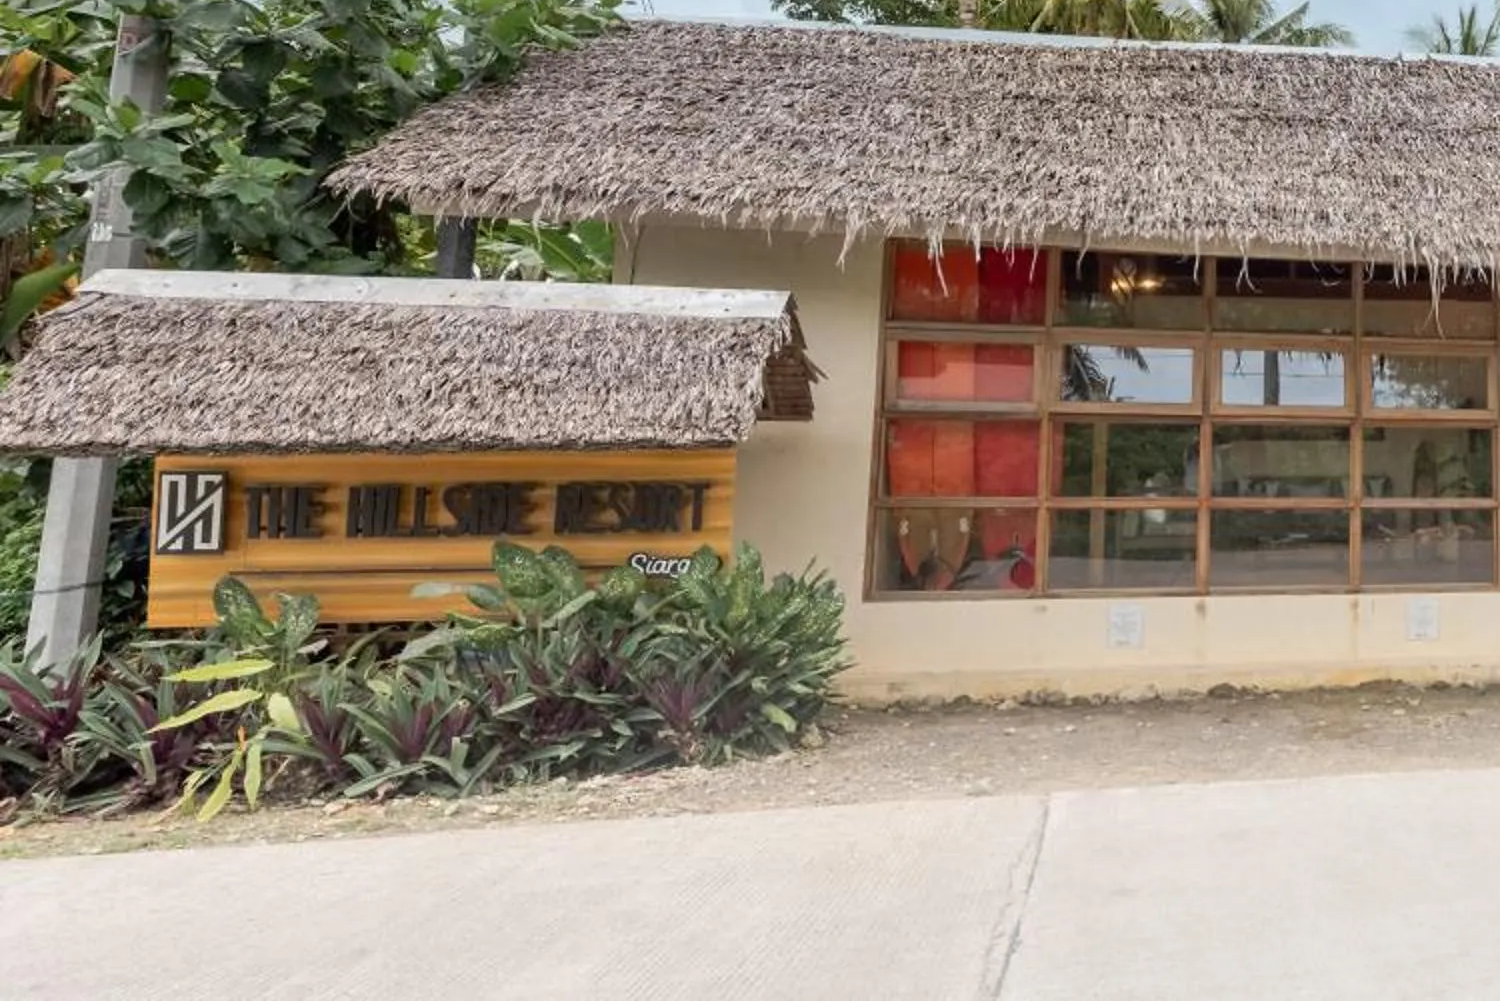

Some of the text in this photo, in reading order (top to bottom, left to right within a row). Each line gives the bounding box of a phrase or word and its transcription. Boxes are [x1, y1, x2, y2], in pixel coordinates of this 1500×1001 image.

[247, 481, 711, 538] THE HILLSIDE RESORT
[630, 554, 694, 578] Siarg
